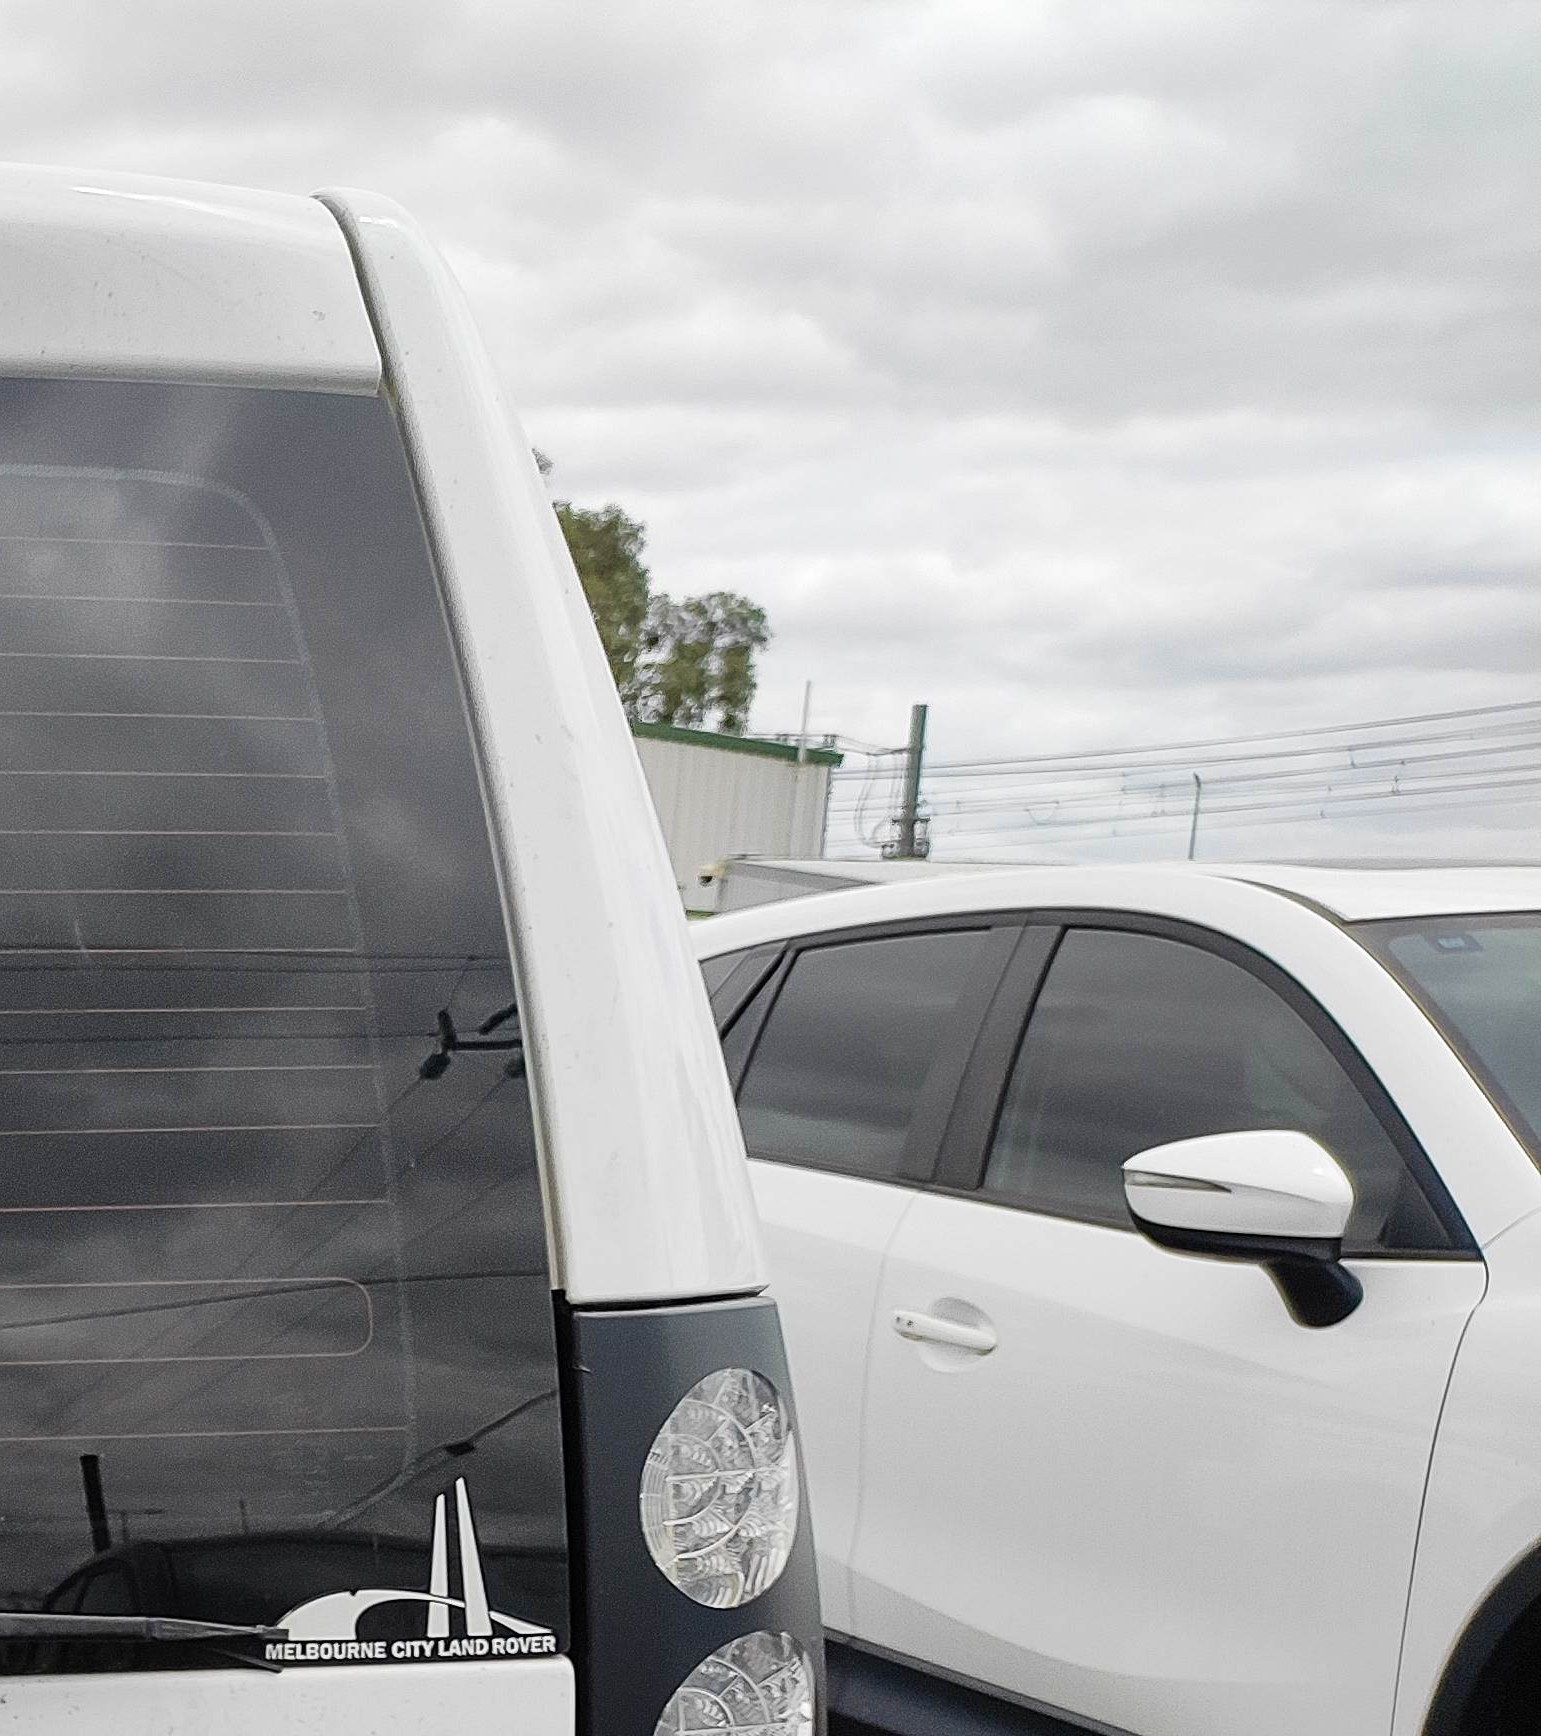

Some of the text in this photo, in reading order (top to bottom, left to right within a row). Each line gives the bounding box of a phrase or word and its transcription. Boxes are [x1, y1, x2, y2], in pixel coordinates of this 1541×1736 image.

[265, 1635, 557, 1660] MELBOURNE CITY LAND ROVER
